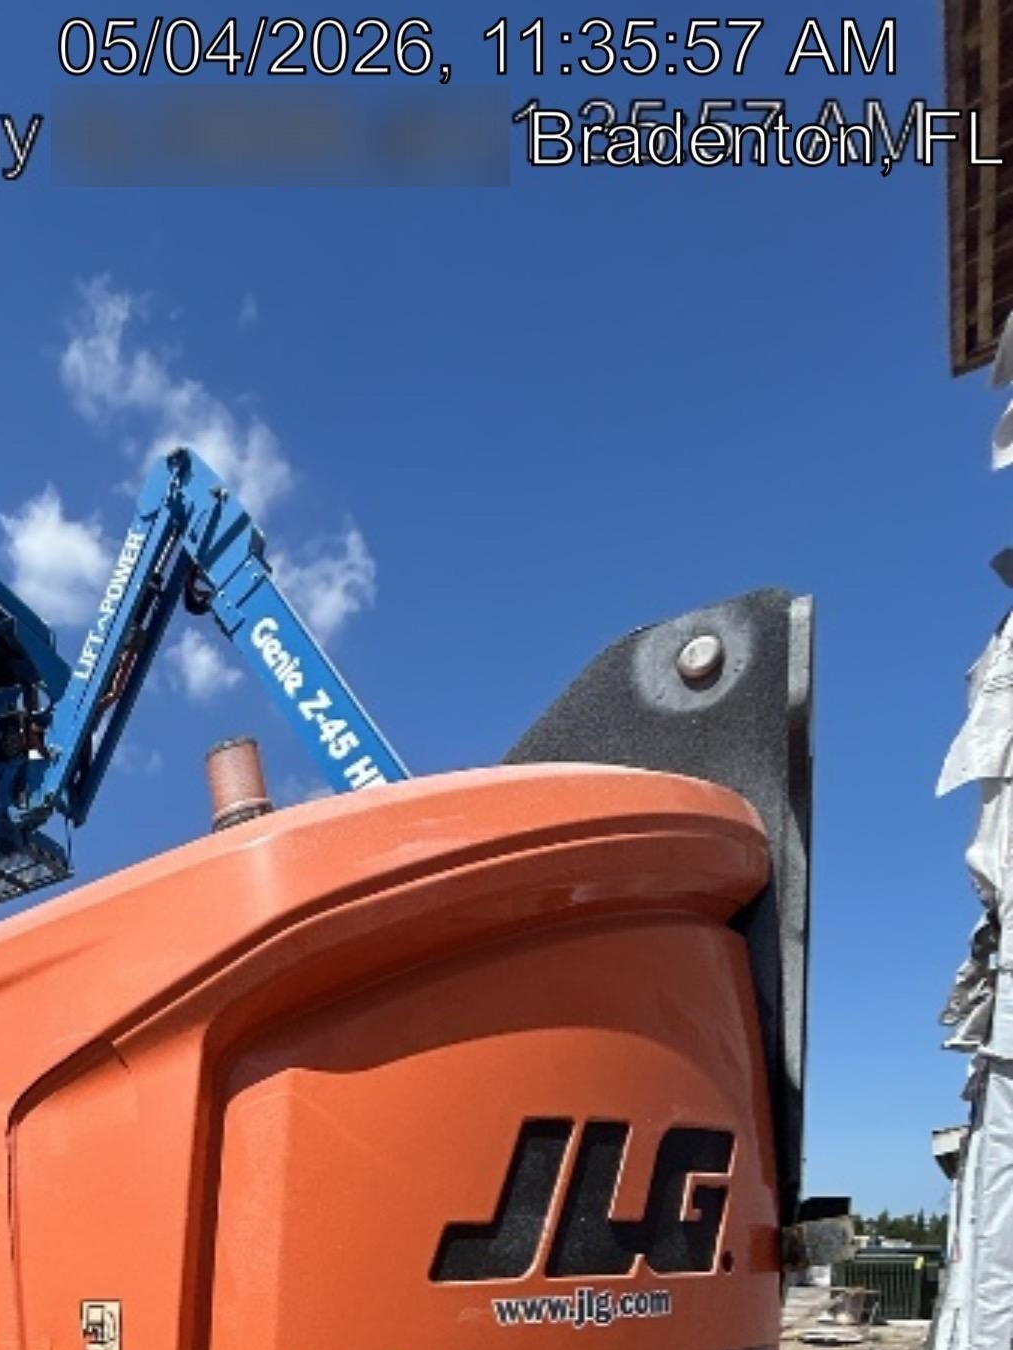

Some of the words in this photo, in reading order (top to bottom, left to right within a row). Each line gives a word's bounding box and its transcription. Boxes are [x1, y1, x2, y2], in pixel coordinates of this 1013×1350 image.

[73, 628, 105, 681] LIFT
[99, 526, 147, 615] POWER
[250, 616, 304, 700] Genie
[297, 687, 361, 762] Z-45
[492, 1287, 672, 1330] www.jlg.com
